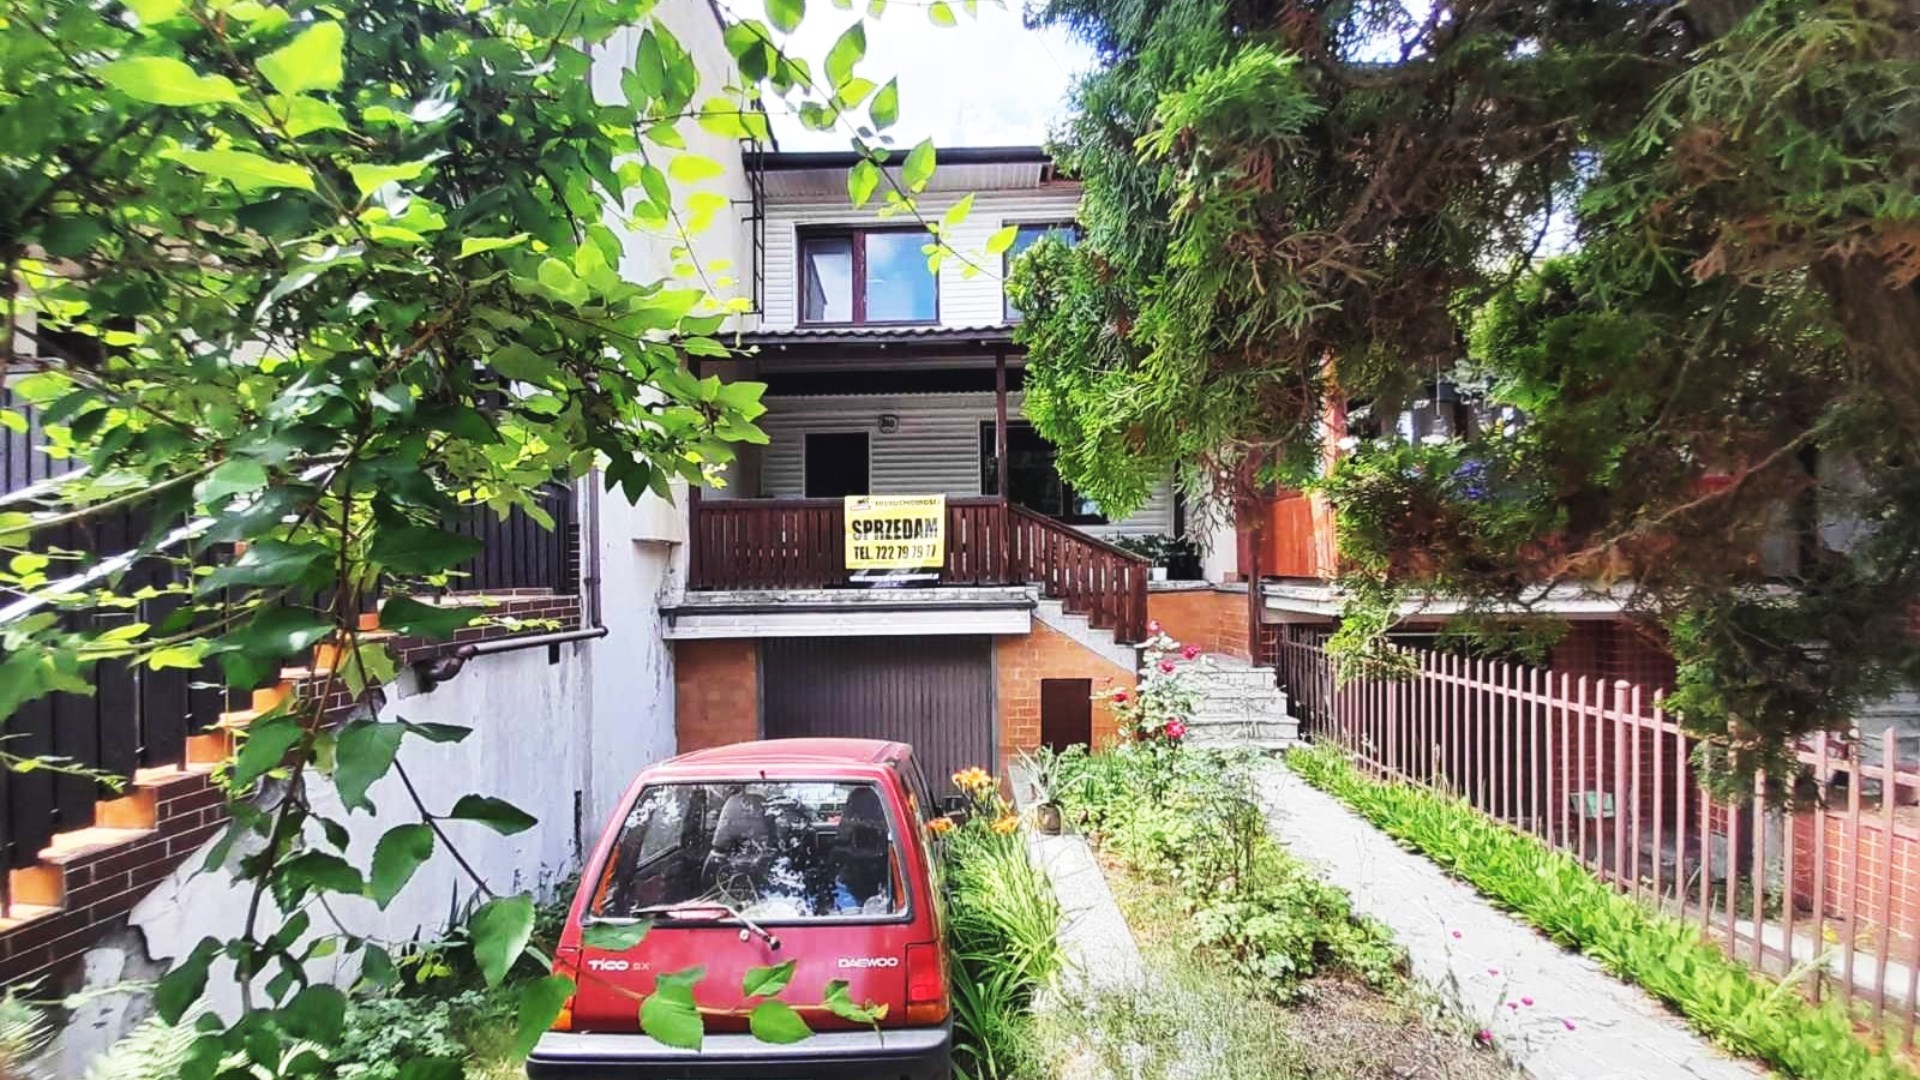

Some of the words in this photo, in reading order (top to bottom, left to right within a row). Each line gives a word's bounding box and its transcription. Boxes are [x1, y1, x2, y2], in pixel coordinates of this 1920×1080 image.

[852, 518, 938, 541] SPRZEDAM
[854, 546, 873, 560] TEL.
[876, 545, 895, 560] 722
[897, 545, 909, 560] 79
[912, 545, 923, 559] 79
[838, 957, 899, 968] DAEWOO
